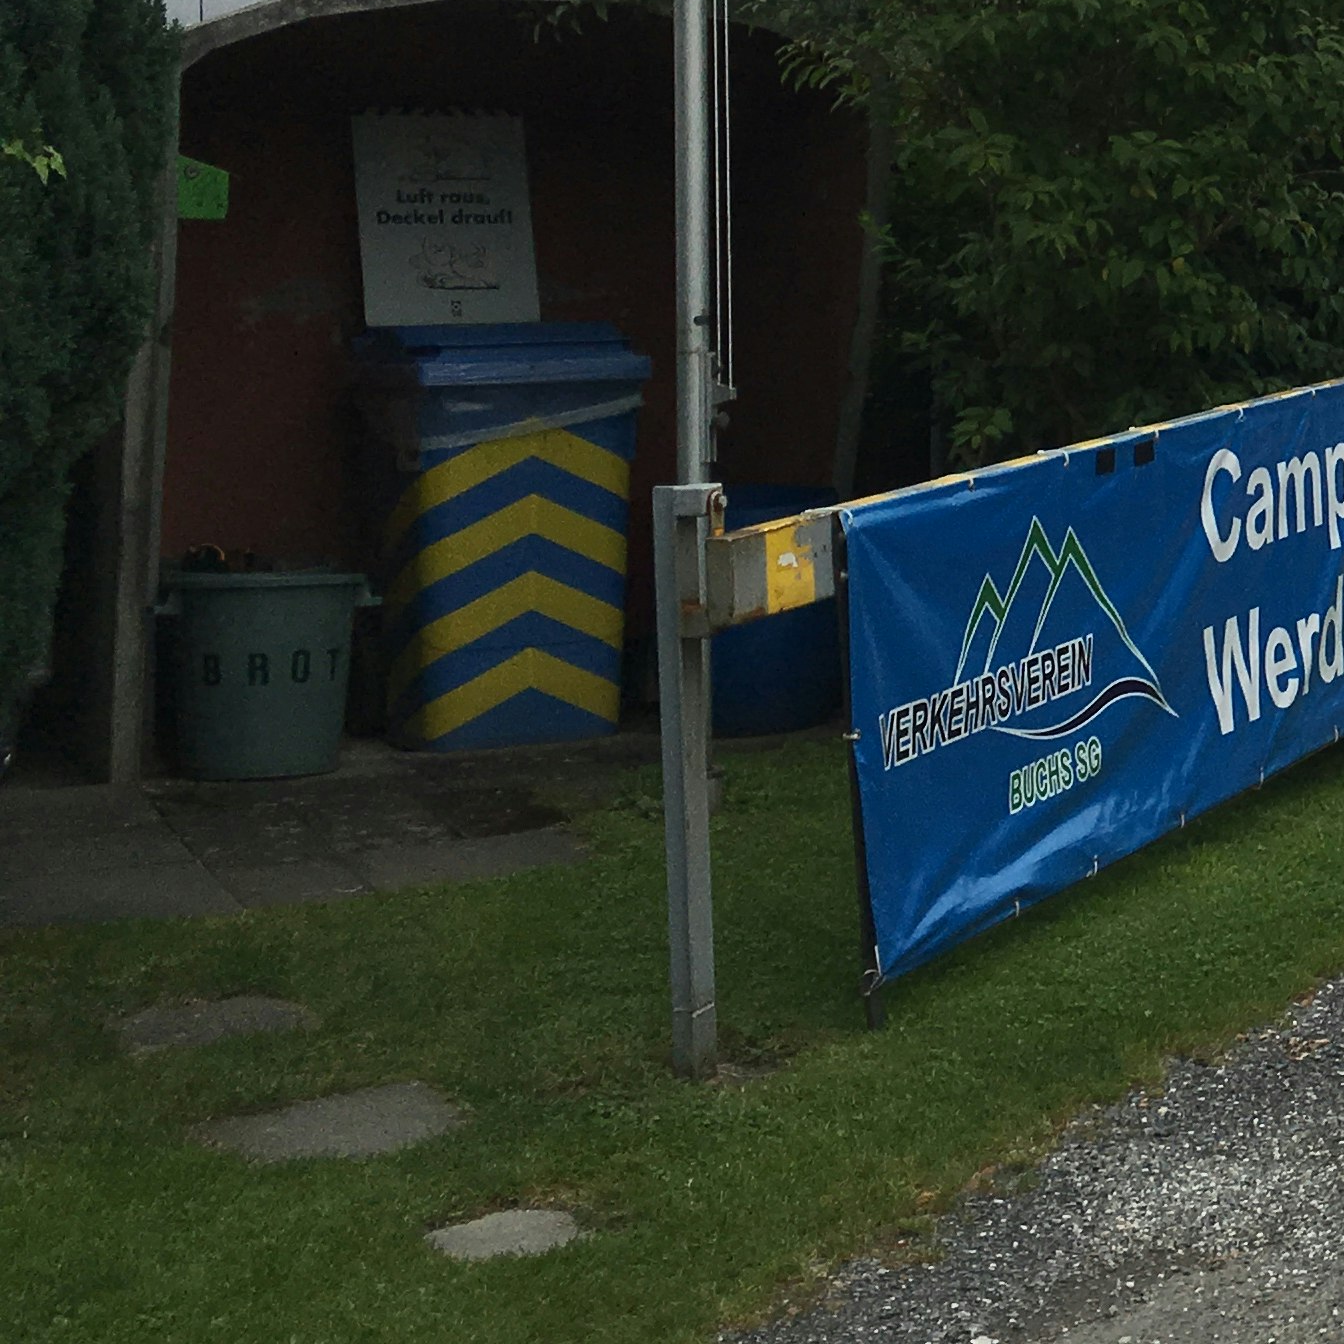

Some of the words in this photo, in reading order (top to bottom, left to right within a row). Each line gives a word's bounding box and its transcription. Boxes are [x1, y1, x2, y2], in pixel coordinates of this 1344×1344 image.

[376, 209, 444, 225] Deckel
[452, 209, 513, 225] drauf!
[396, 188, 433, 205] Luft
[878, 633, 1093, 771] VERKEHRSVEREIN
[1008, 748, 1073, 815] BUCHS
[1075, 735, 1102, 783] SG
